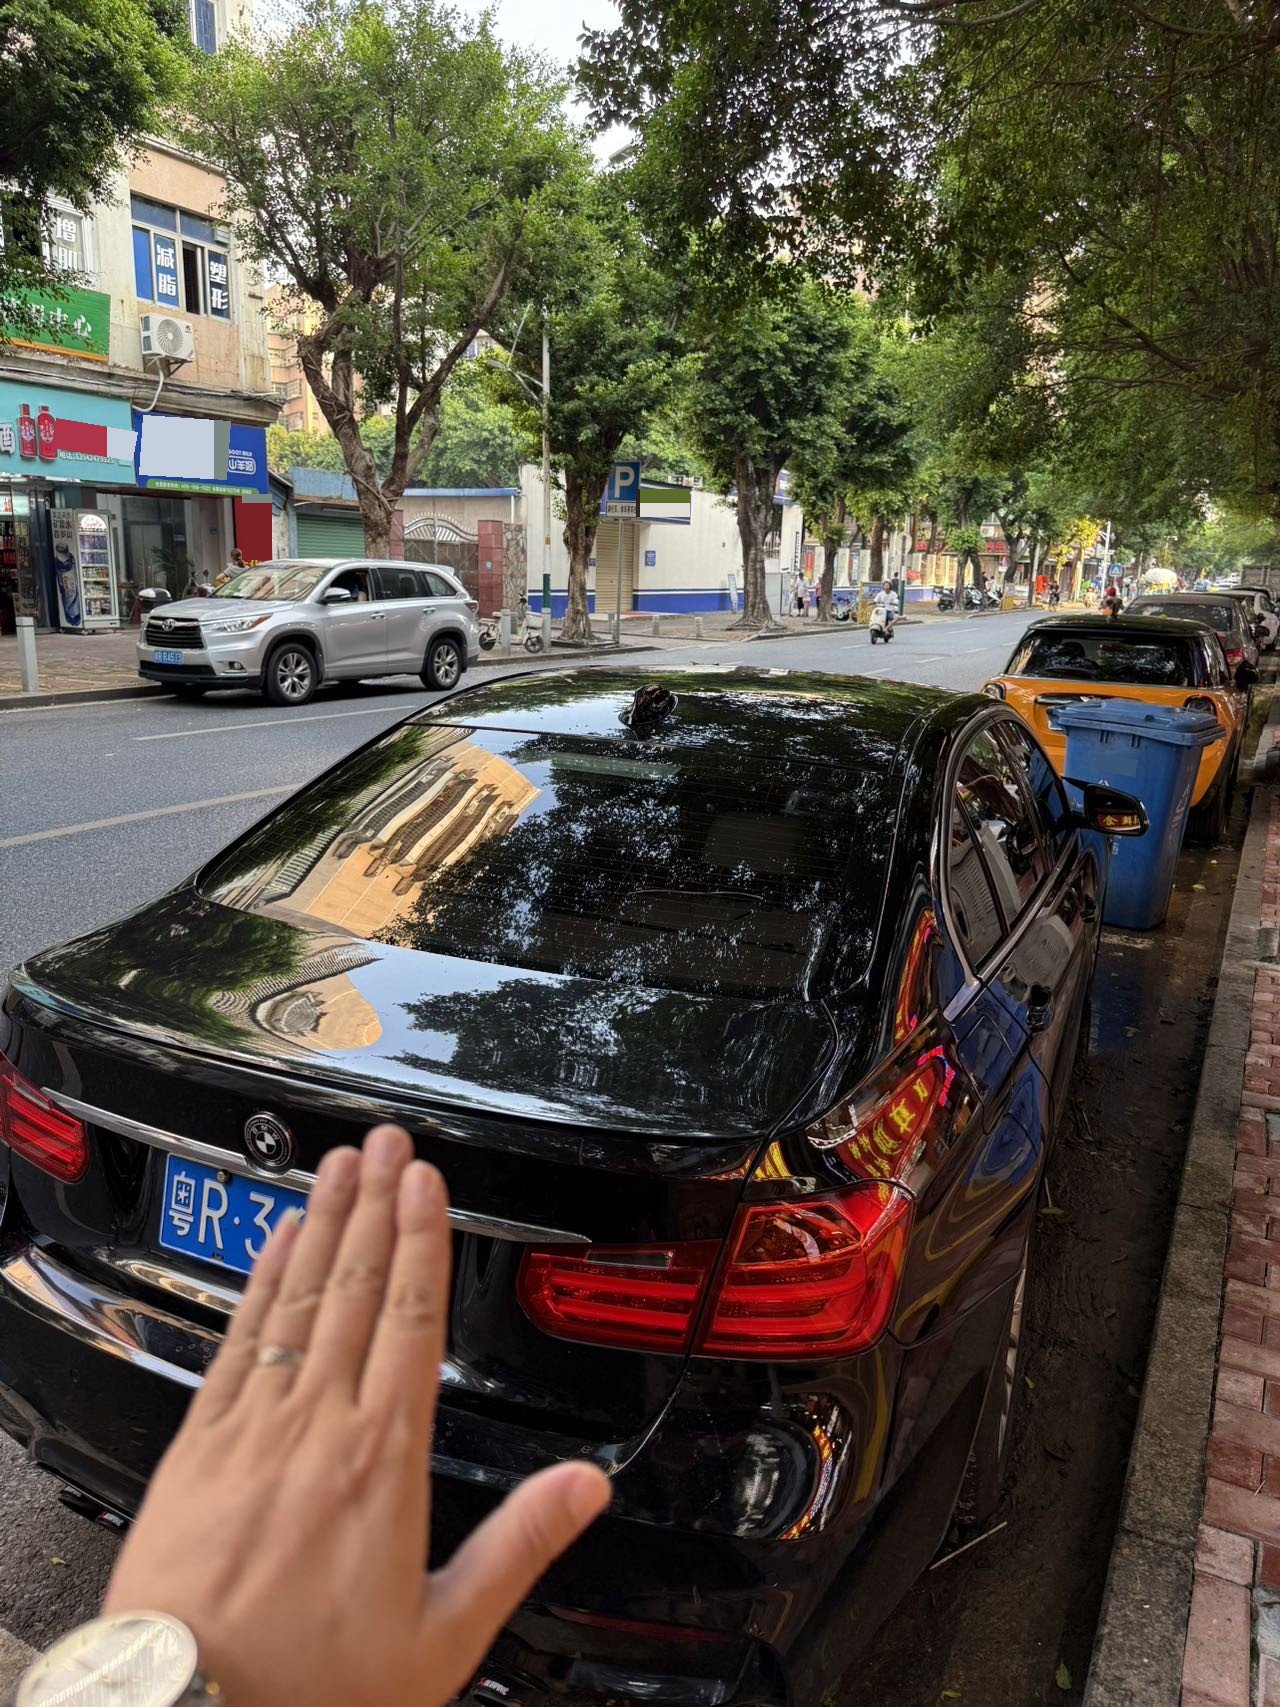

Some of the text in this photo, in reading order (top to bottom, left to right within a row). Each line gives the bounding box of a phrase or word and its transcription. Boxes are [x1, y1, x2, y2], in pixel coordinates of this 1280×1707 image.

[157, 244, 176, 297] 减脂
[210, 261, 228, 309] 塑形
[614, 466, 634, 498] P
